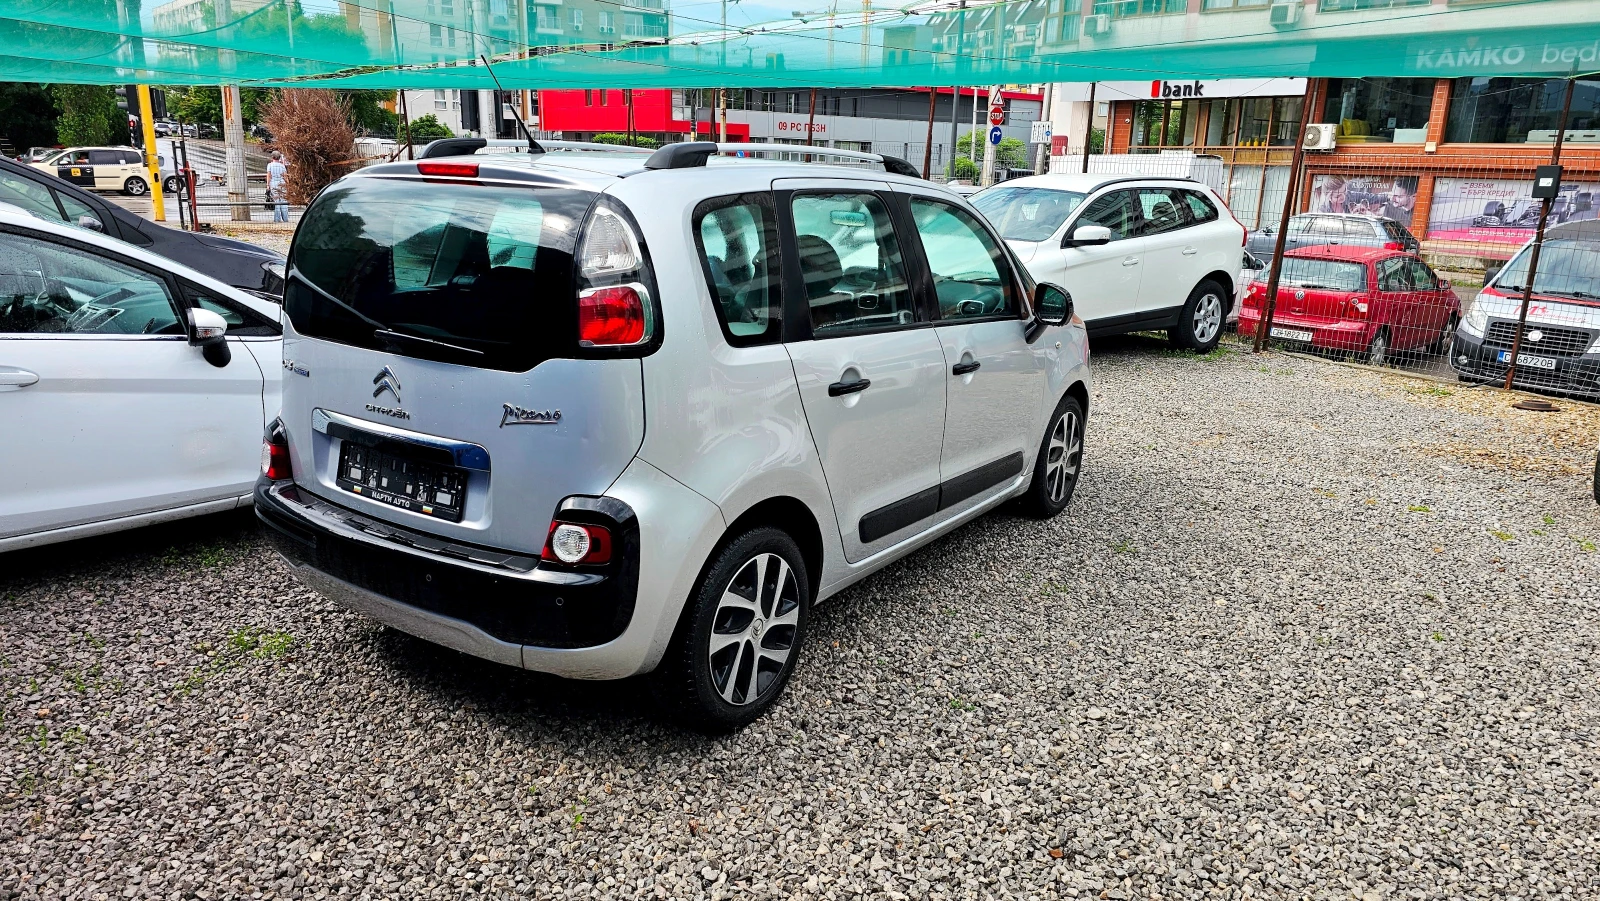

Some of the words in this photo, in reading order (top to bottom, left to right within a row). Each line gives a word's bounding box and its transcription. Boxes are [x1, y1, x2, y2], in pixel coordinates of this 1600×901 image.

[1416, 44, 1526, 69] KAMKO
[1541, 40, 1600, 64] bed
[990, 112, 1003, 120] STOP
[778, 121, 788, 131] 09
[790, 122, 802, 132] РС
